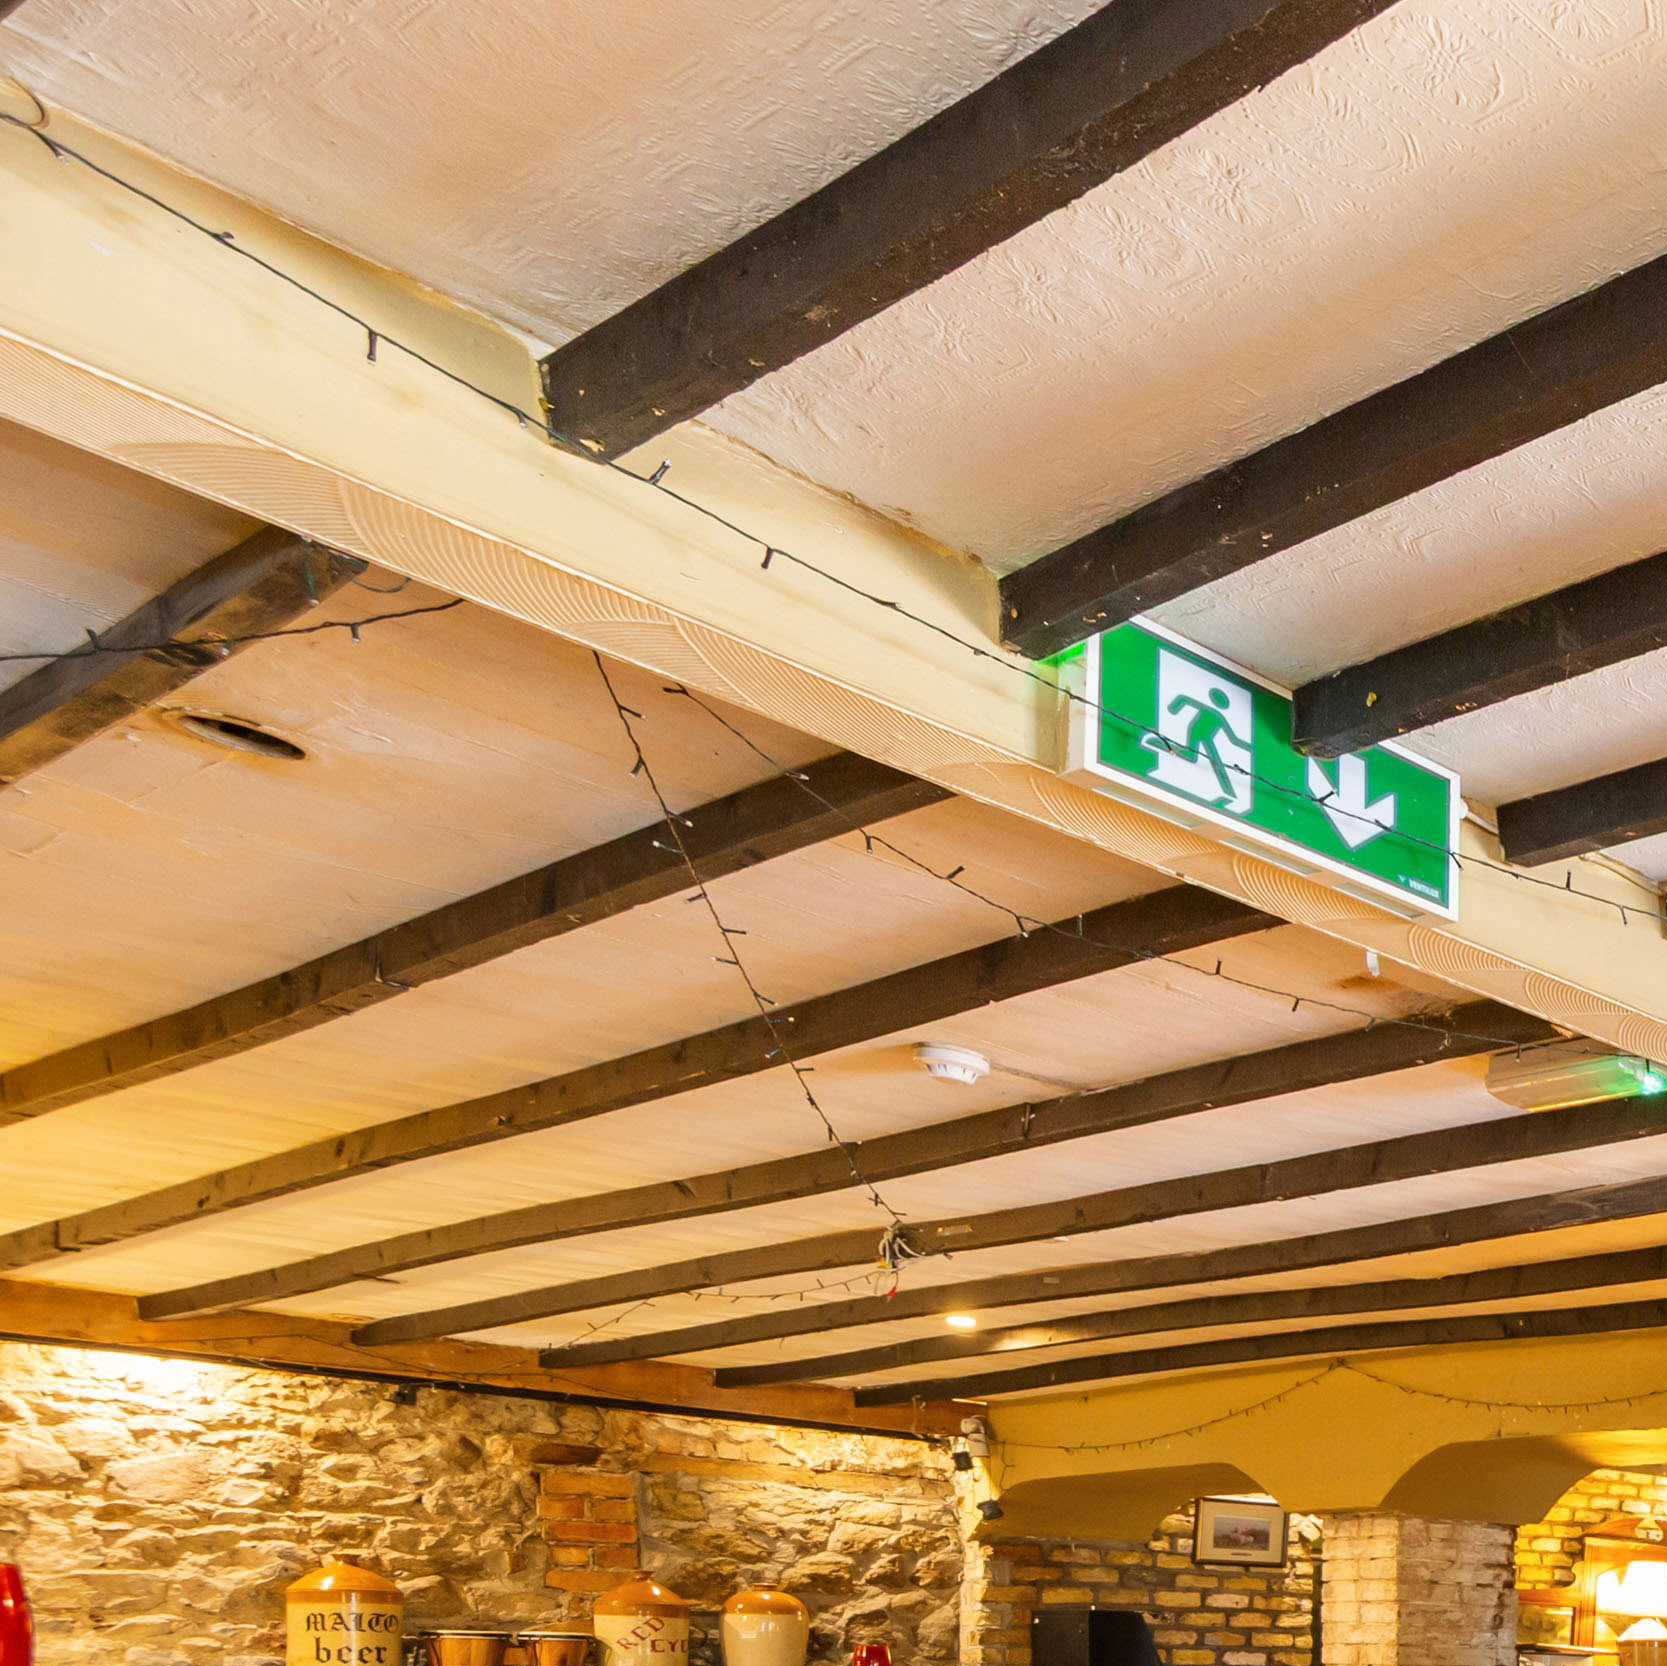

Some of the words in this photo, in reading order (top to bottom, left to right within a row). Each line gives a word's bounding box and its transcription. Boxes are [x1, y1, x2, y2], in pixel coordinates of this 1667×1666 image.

[306, 1612, 399, 1634] MALTO
[616, 1617, 665, 1650] RED
[314, 1637, 388, 1664] beer
